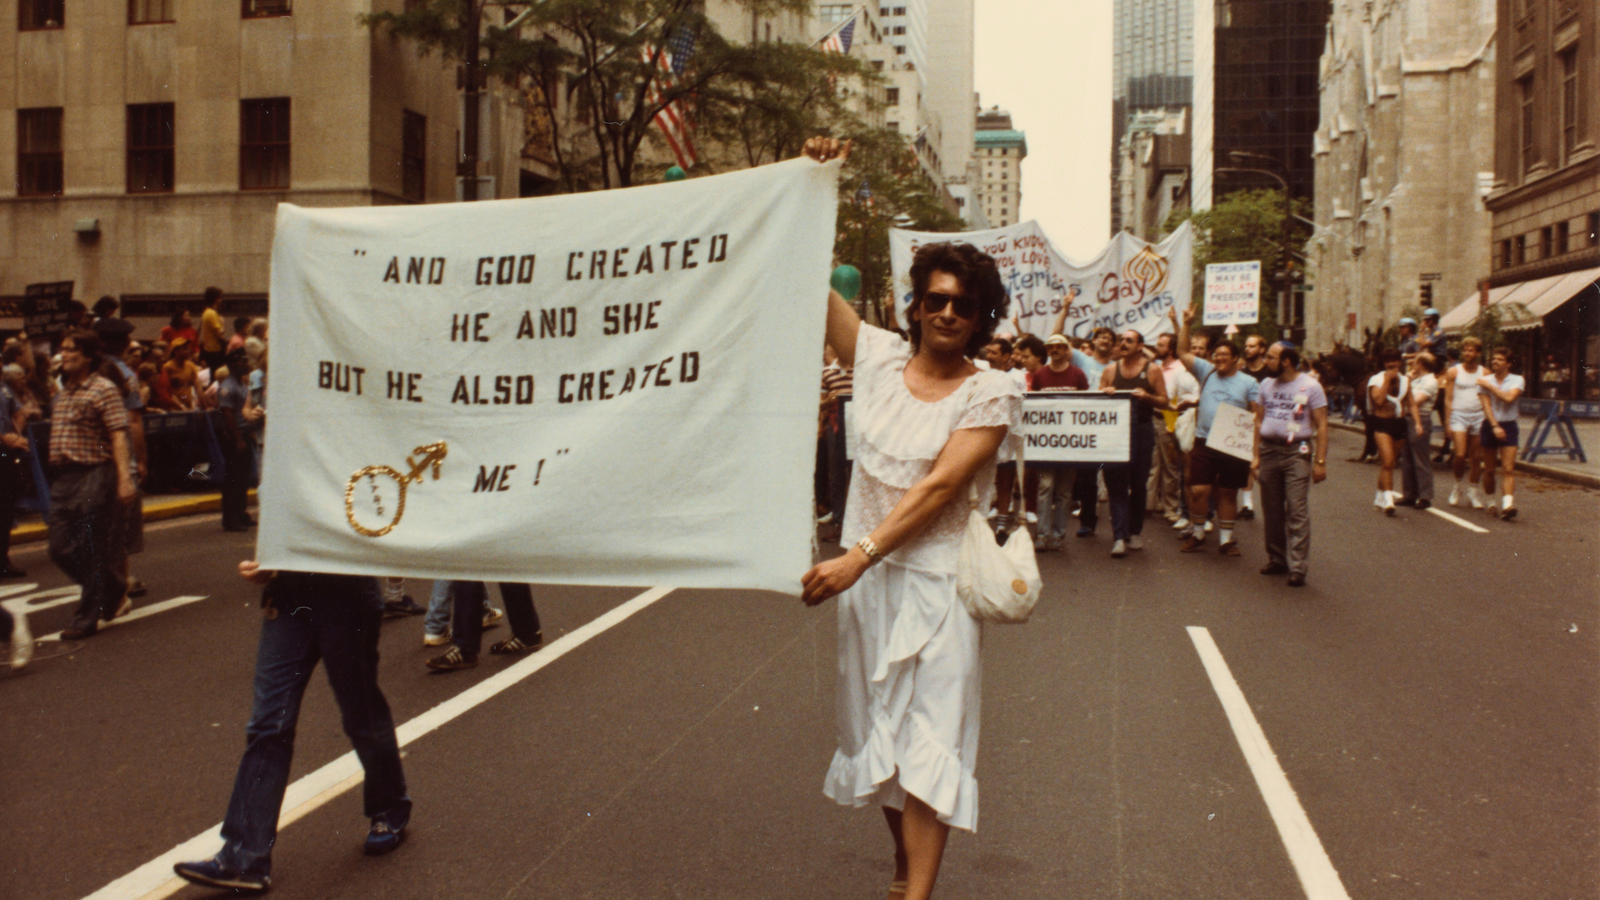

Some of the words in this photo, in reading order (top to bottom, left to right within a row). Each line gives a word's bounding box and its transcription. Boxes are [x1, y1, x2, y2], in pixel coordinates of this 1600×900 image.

[983, 242, 1007, 255] YOU
[383, 255, 446, 285] AND
[475, 254, 535, 286] GOD
[565, 233, 729, 281] CREATED
[995, 255, 1016, 270] YOU
[1209, 264, 1259, 273] TOMORROW
[1215, 274, 1236, 282] MAY
[1240, 273, 1251, 281] BE
[1096, 271, 1147, 305] Gay
[1208, 284, 1226, 292] TOO
[1231, 282, 1256, 292] LATE
[1211, 292, 1254, 301] FREEDOM
[1206, 302, 1254, 311] EQUALITY
[450, 311, 491, 343] HE
[516, 306, 578, 340] AND
[602, 299, 662, 336] SHE
[1207, 311, 1234, 320] RIGHT
[1239, 311, 1257, 319] NOW
[318, 360, 366, 396] BUT
[386, 370, 424, 403] HE
[450, 374, 534, 405] ALSO
[557, 351, 701, 404] CREATED
[1070, 411, 1118, 425] TORAH
[1025, 434, 1097, 448] NOGOGUE
[471, 464, 517, 493] ME
